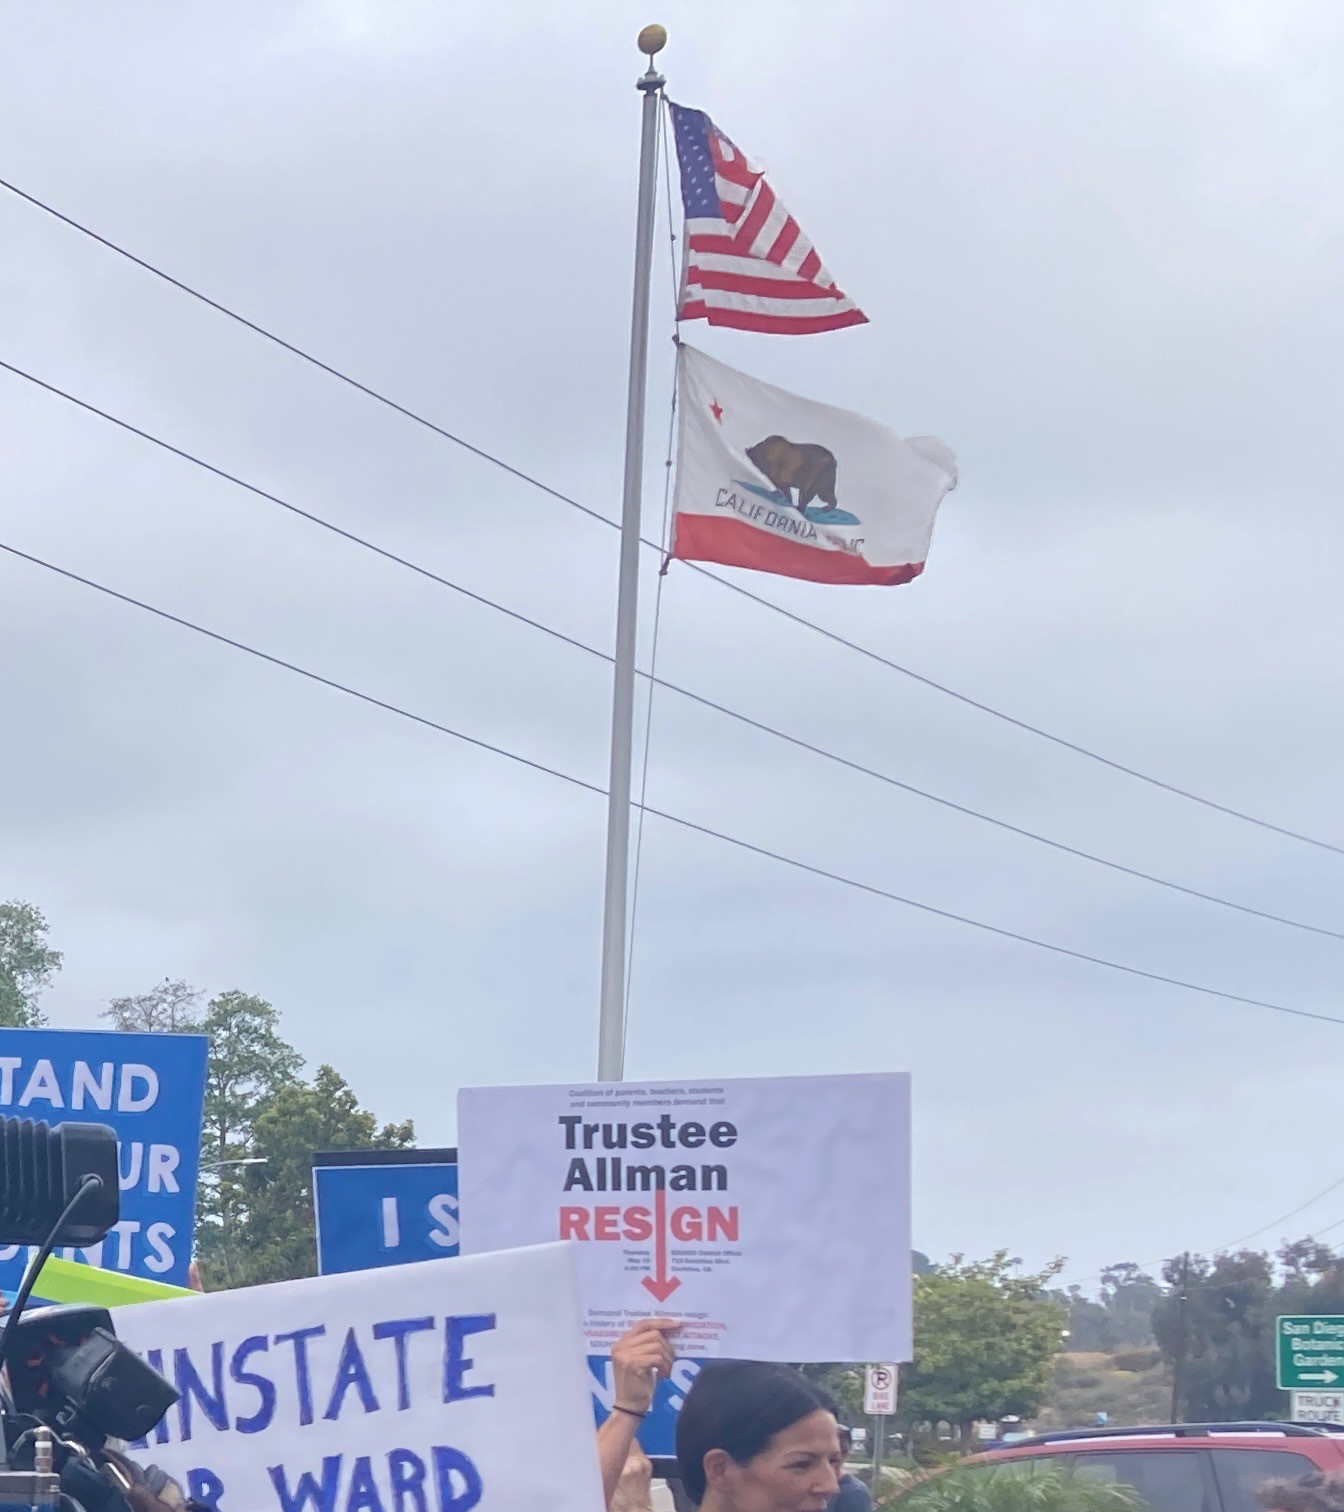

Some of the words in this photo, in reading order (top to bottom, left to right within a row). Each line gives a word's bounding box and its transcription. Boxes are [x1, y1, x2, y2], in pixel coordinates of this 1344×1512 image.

[715, 487, 818, 540] CALIFORNIA
[558, 1114, 738, 1149] Trustee
[117, 1141, 180, 1194] UR
[562, 1157, 728, 1191] Allman
[382, 1197, 400, 1247] I
[559, 1206, 739, 1241] RESIGN
[1282, 1321, 1310, 1335] San
[1312, 1320, 1344, 1337] Dieg
[129, 1312, 496, 1450] INSTATE
[1298, 1395, 1341, 1407] TRUCK
[1298, 1410, 1341, 1421] ROUTE
